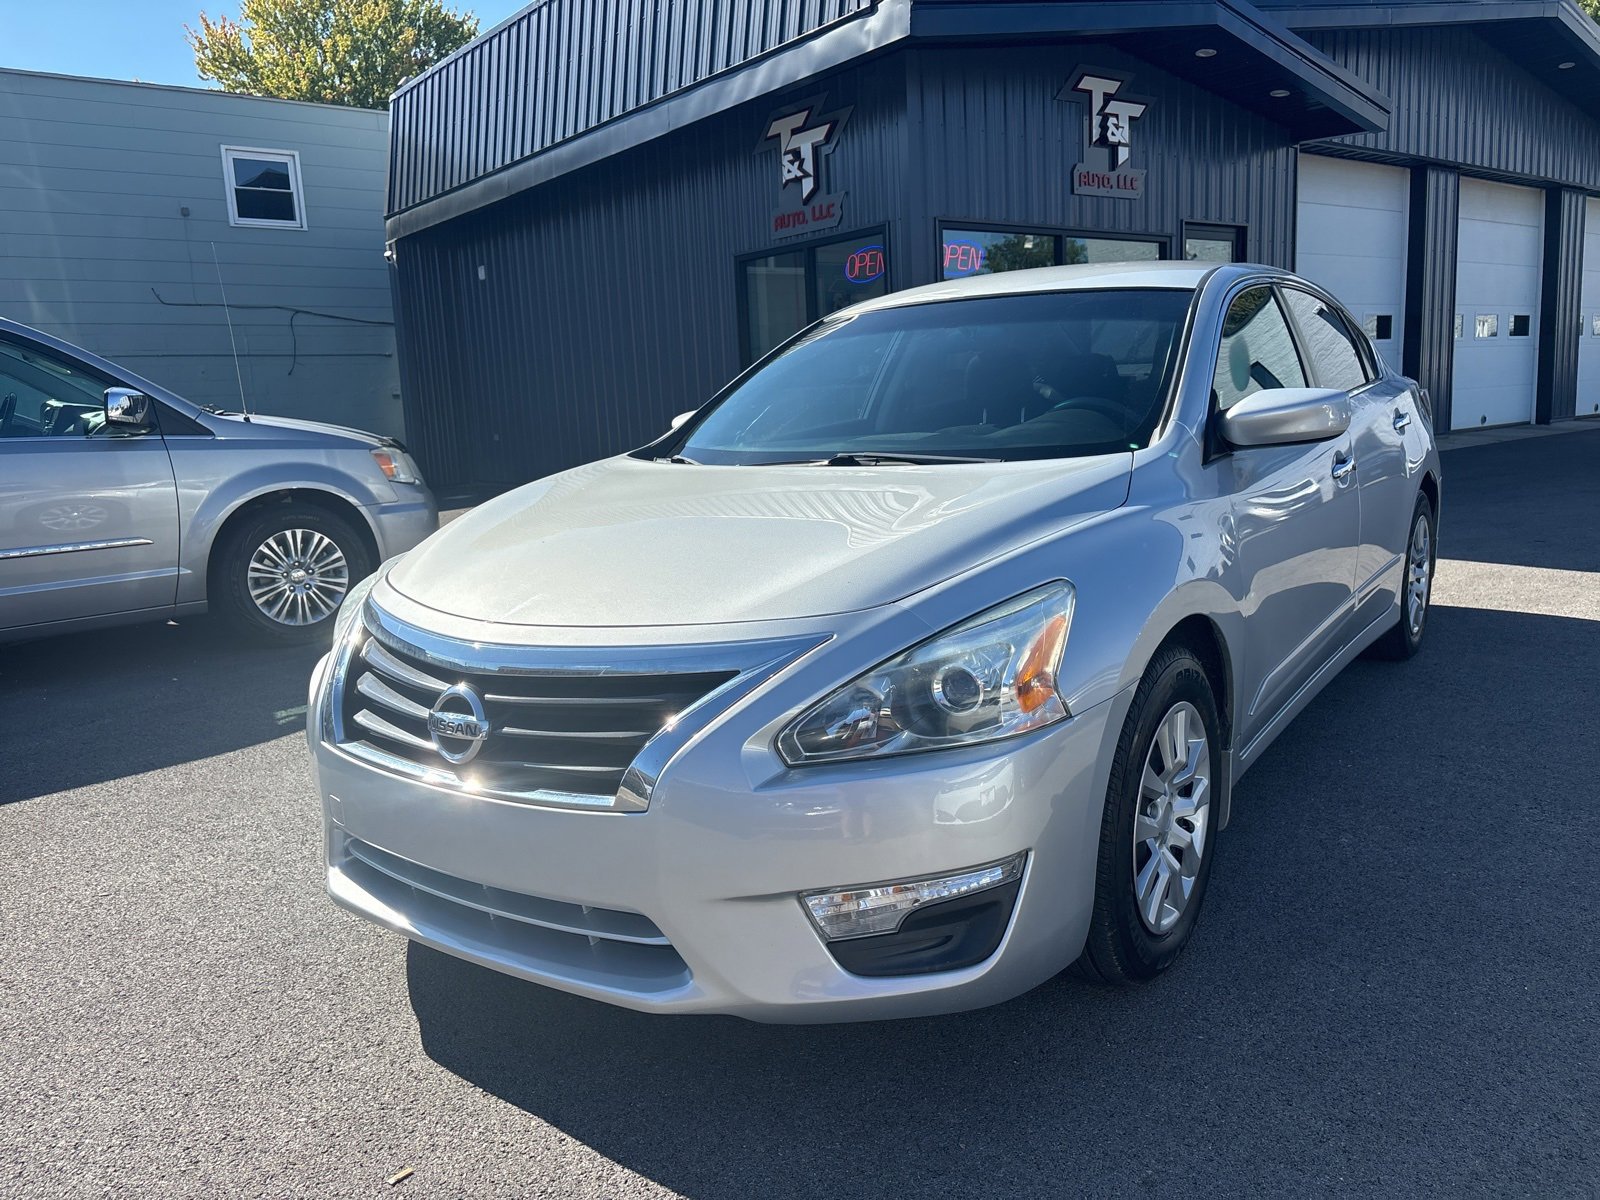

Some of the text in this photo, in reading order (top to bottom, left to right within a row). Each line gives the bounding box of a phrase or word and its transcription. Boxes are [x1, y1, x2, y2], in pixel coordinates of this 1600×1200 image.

[1117, 173, 1138, 190] LLC
[812, 203, 835, 222] LLC
[431, 717, 478, 736] NISSAN
